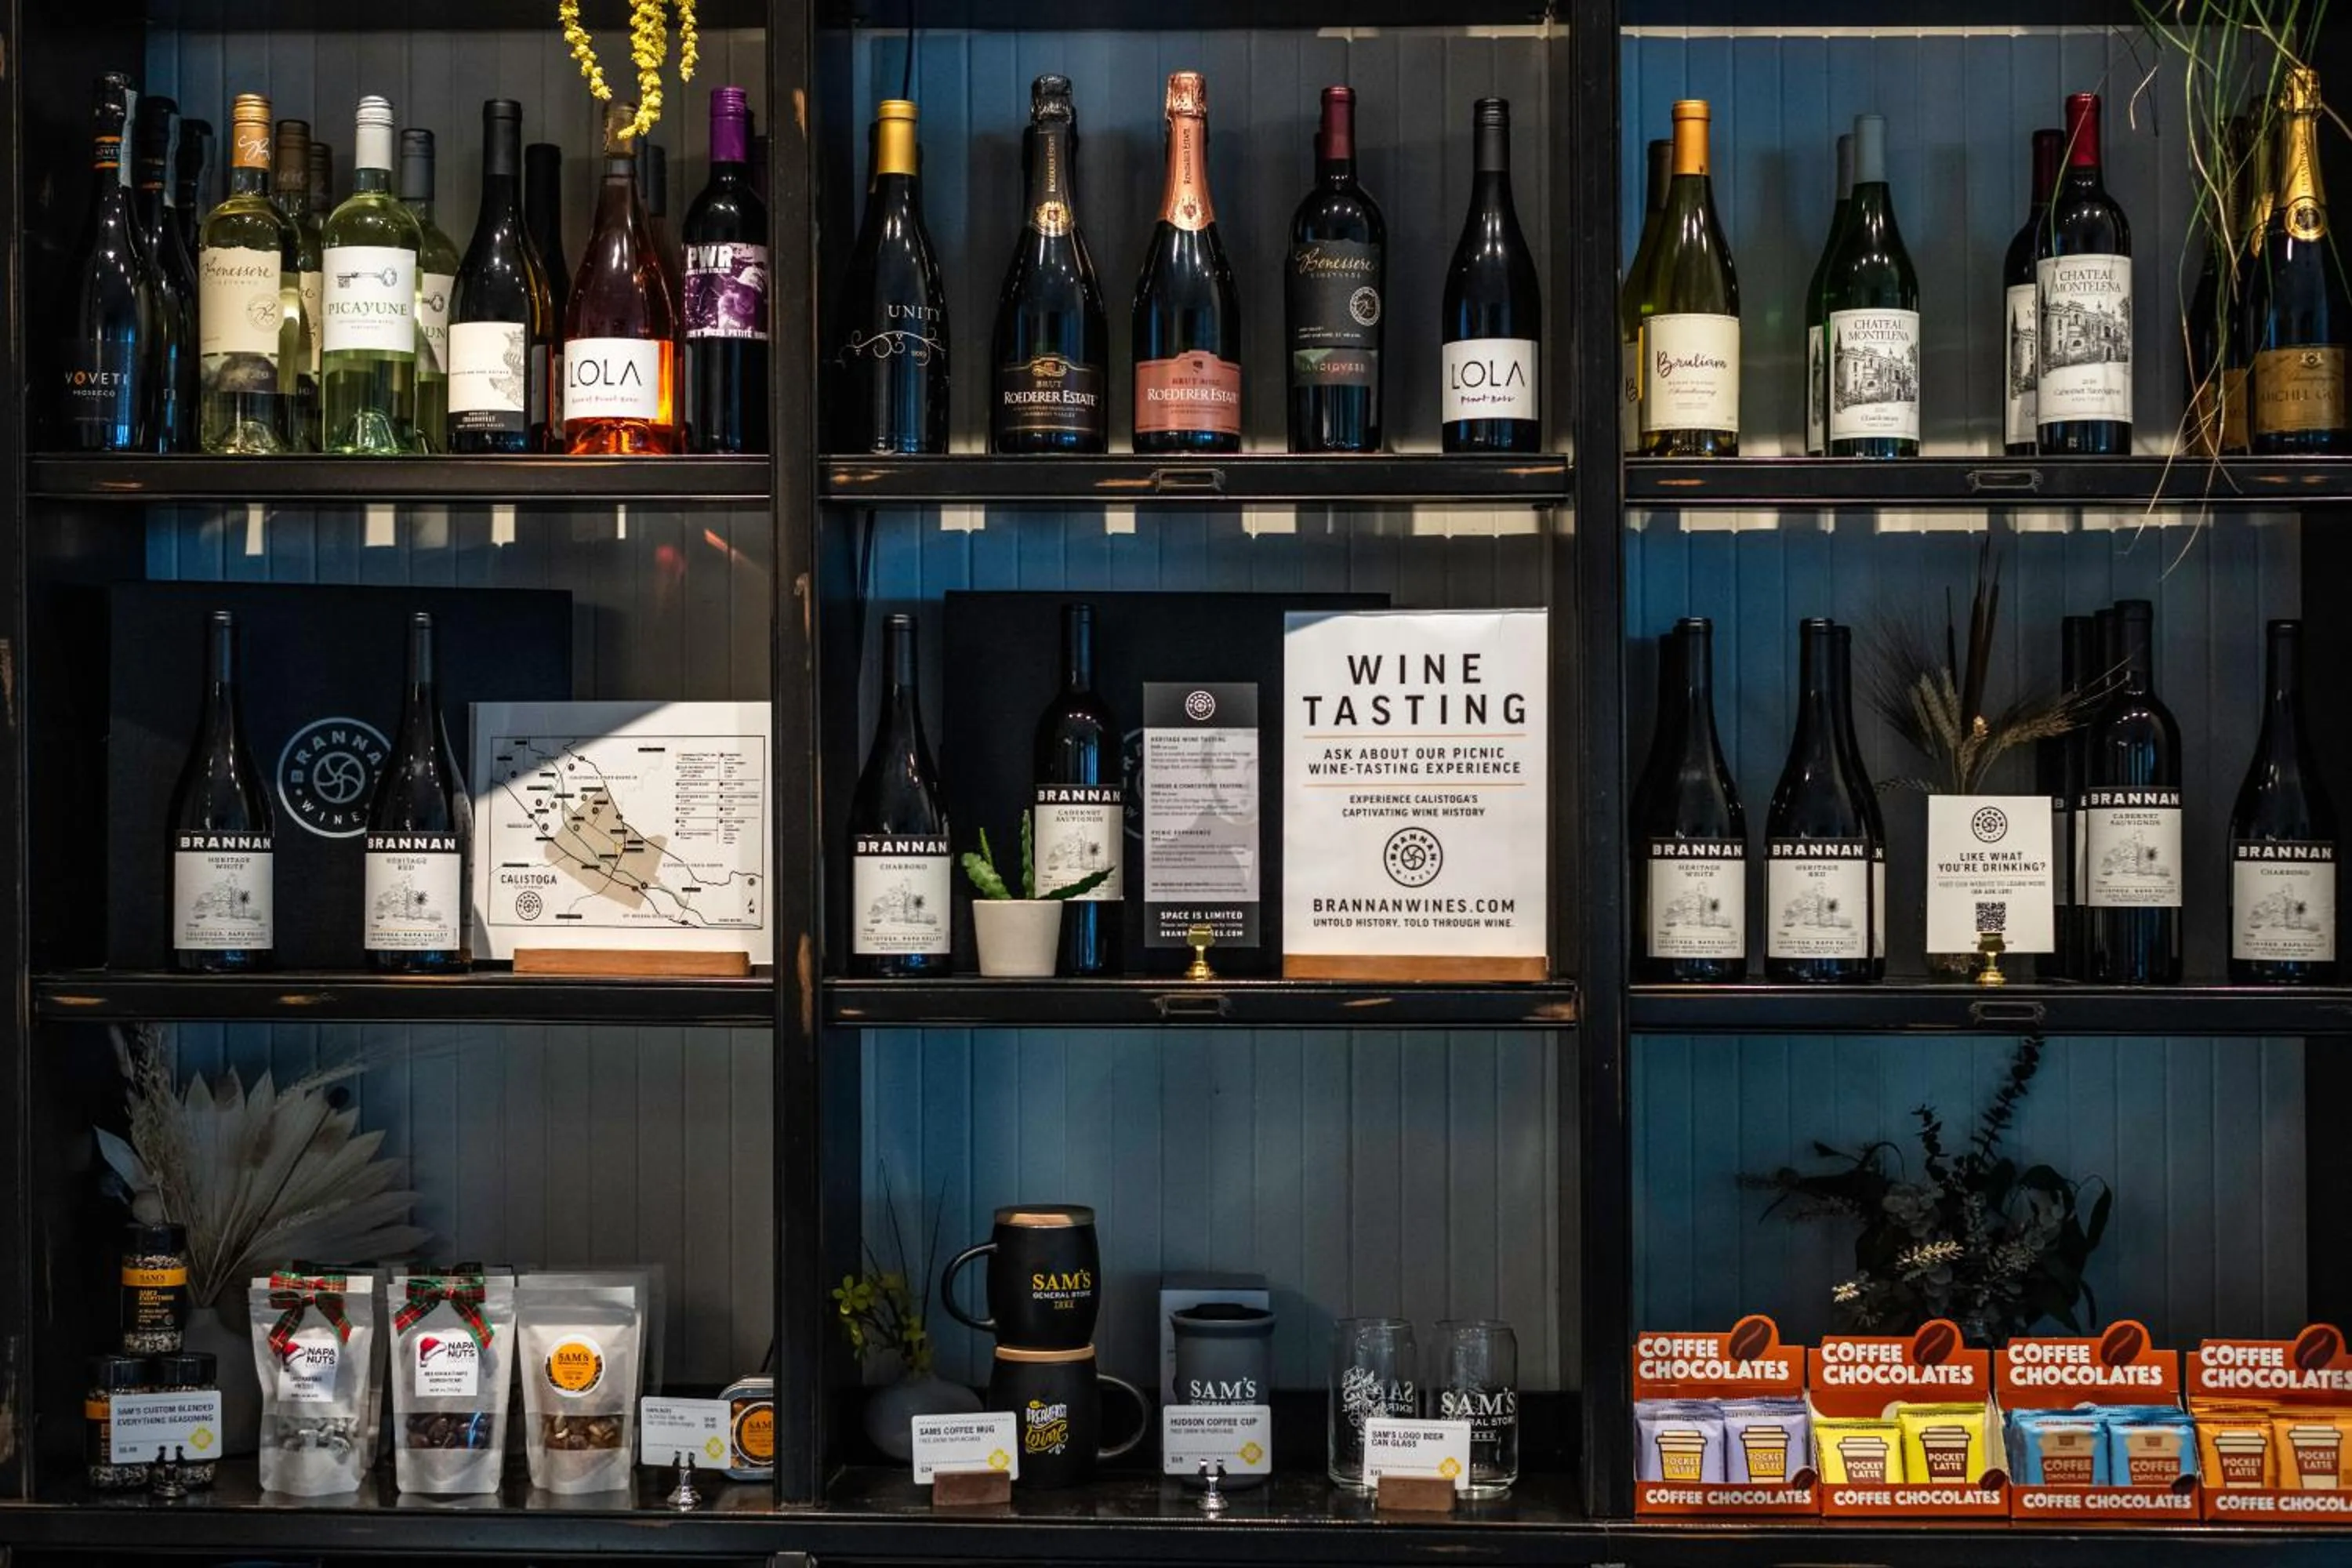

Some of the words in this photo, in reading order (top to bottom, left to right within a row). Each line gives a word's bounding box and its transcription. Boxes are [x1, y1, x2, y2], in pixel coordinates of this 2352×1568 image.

[688, 245, 732, 269] PWR
[2055, 281, 2122, 293] MONTELENA
[328, 301, 408, 316] PICAYUNE
[888, 304, 941, 321] UNITY
[1848, 330, 1910, 341] MONTELENA
[65, 372, 128, 385] VOVETI
[570, 359, 641, 387] LOLA
[1451, 360, 1526, 390] LOLA
[1004, 391, 1062, 405] ROEDERER
[1062, 390, 1096, 406] ESTATE
[1147, 389, 1209, 401] ROEDERER
[1347, 653, 1481, 685] WINE
[1302, 693, 1526, 726] TASTING
[291, 730, 383, 784] BRANNA
[1324, 749, 1352, 760] ASK
[1359, 748, 1409, 760] ABOUT
[1416, 748, 1446, 759] OUR
[1454, 747, 1504, 759] PICNIC
[1308, 763, 1419, 775] WINE-TASTING
[1426, 761, 1521, 774] EXPERIENCE
[1038, 789, 1121, 801] BRANNAN
[1349, 794, 1411, 804] EXPERIENCE
[1415, 794, 1478, 804] CALISTOGA'S
[2091, 793, 2180, 805] BRANNAN
[301, 798, 361, 826] WINE
[1342, 808, 1409, 817] CAPTIVATING
[1412, 808, 1439, 817] WINE
[1442, 808, 1485, 816] HISTORY
[180, 837, 271, 850] BRANNAN
[368, 837, 456, 850] BRANNAN
[857, 841, 947, 853] BRANNAN
[1390, 833, 1436, 861] BRANNAN
[1653, 844, 1742, 856] BRANNAN
[1772, 844, 1864, 856] BRANNAN
[1960, 852, 1985, 861] LIKE
[1990, 851, 2023, 861] WHAT
[2238, 846, 2332, 858] BRANNAN
[1938, 863, 1978, 872] YOU'RE
[1983, 862, 2046, 872] DRINKING?
[500, 874, 557, 886] CALISTOGA
[1313, 898, 1515, 913] BRANNANWINES.COM
[1160, 911, 1189, 920] SPACE
[1192, 911, 1202, 920] IS
[1205, 911, 1243, 920] LIMITED
[1313, 918, 1352, 927] UNTOLD
[1404, 918, 1429, 927] TOLD
[1433, 918, 1480, 927] THROUGH
[1033, 1267, 1091, 1290] SAM'S
[307, 1347, 336, 1356] NAPA
[448, 1349, 475, 1358] NUTS
[1638, 1338, 1719, 1359] COFFEE
[1821, 1341, 1902, 1363] COFFEE
[2008, 1344, 2090, 1364] COFFEE
[307, 1356, 336, 1364] NUTS
[2200, 1345, 2284, 1367] COFFEE
[1639, 1359, 1789, 1381] CHOCOLATES
[1823, 1363, 1974, 1385] CHOCOLATES
[2009, 1365, 2163, 1386] CHOCOLATES
[1190, 1377, 1257, 1399] SAM'S
[1442, 1386, 1515, 1416] SAM'S
[143, 1406, 176, 1414] CUSTOM
[118, 1417, 166, 1426] EVERYTHING
[749, 1420, 773, 1429] SAM
[1171, 1417, 1204, 1426] HUDSON
[1207, 1417, 1237, 1426] COFFEE
[943, 1426, 974, 1435] COFFEE
[976, 1425, 995, 1433] MUG
[1372, 1431, 1396, 1439] SAM'S
[1399, 1432, 1421, 1440] LOGO
[1371, 1439, 1388, 1447] CAN
[1391, 1439, 1417, 1448] GLASS
[1748, 1453, 1784, 1461] POCKET
[1928, 1453, 1965, 1461] POCKET
[2298, 1451, 2336, 1461] POCKET
[1846, 1461, 1883, 1470] POCKET
[1933, 1461, 1962, 1470] LATTE
[2043, 1459, 2091, 1472] COFFEE
[2130, 1461, 2178, 1472] COFFEE
[2222, 1457, 2261, 1468] POCKET
[2303, 1461, 2333, 1470] LATTE
[1852, 1469, 1881, 1479] LATTE
[2229, 1467, 2258, 1477] LATTE
[1646, 1489, 1703, 1504] COFFEE
[1707, 1489, 1811, 1505] CHOCOLATES
[1834, 1490, 1891, 1506] COFFEE
[1896, 1490, 2000, 1506] CHOCOLATES
[2023, 1493, 2081, 1509] COFFEE
[2085, 1493, 2192, 1509] CHOCOLATES
[2216, 1495, 2274, 1511] COFFEE
